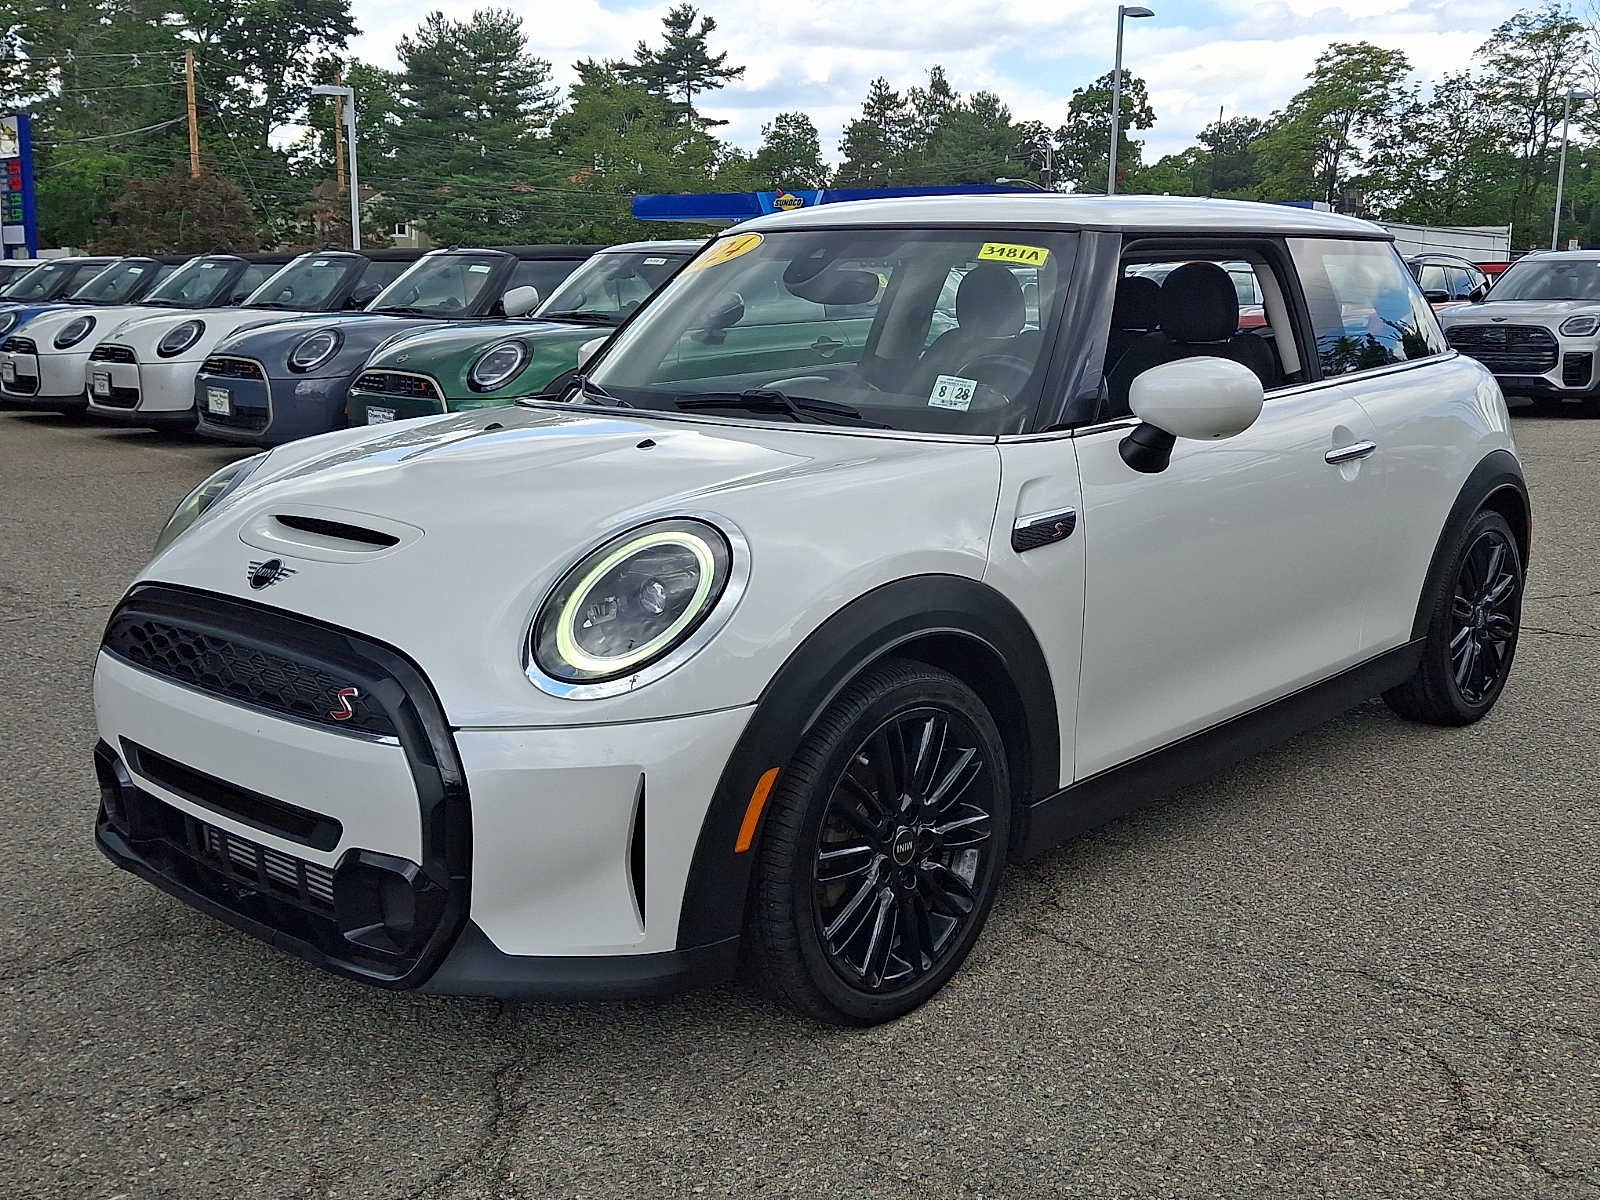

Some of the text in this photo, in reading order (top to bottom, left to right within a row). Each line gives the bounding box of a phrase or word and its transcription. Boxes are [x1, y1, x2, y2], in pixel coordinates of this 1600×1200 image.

[938, 385, 970, 400] 8 28
[1052, 521, 1064, 539] S
[256, 567, 277, 578] MINI
[329, 687, 358, 720] S
[896, 840, 913, 854] MINI
